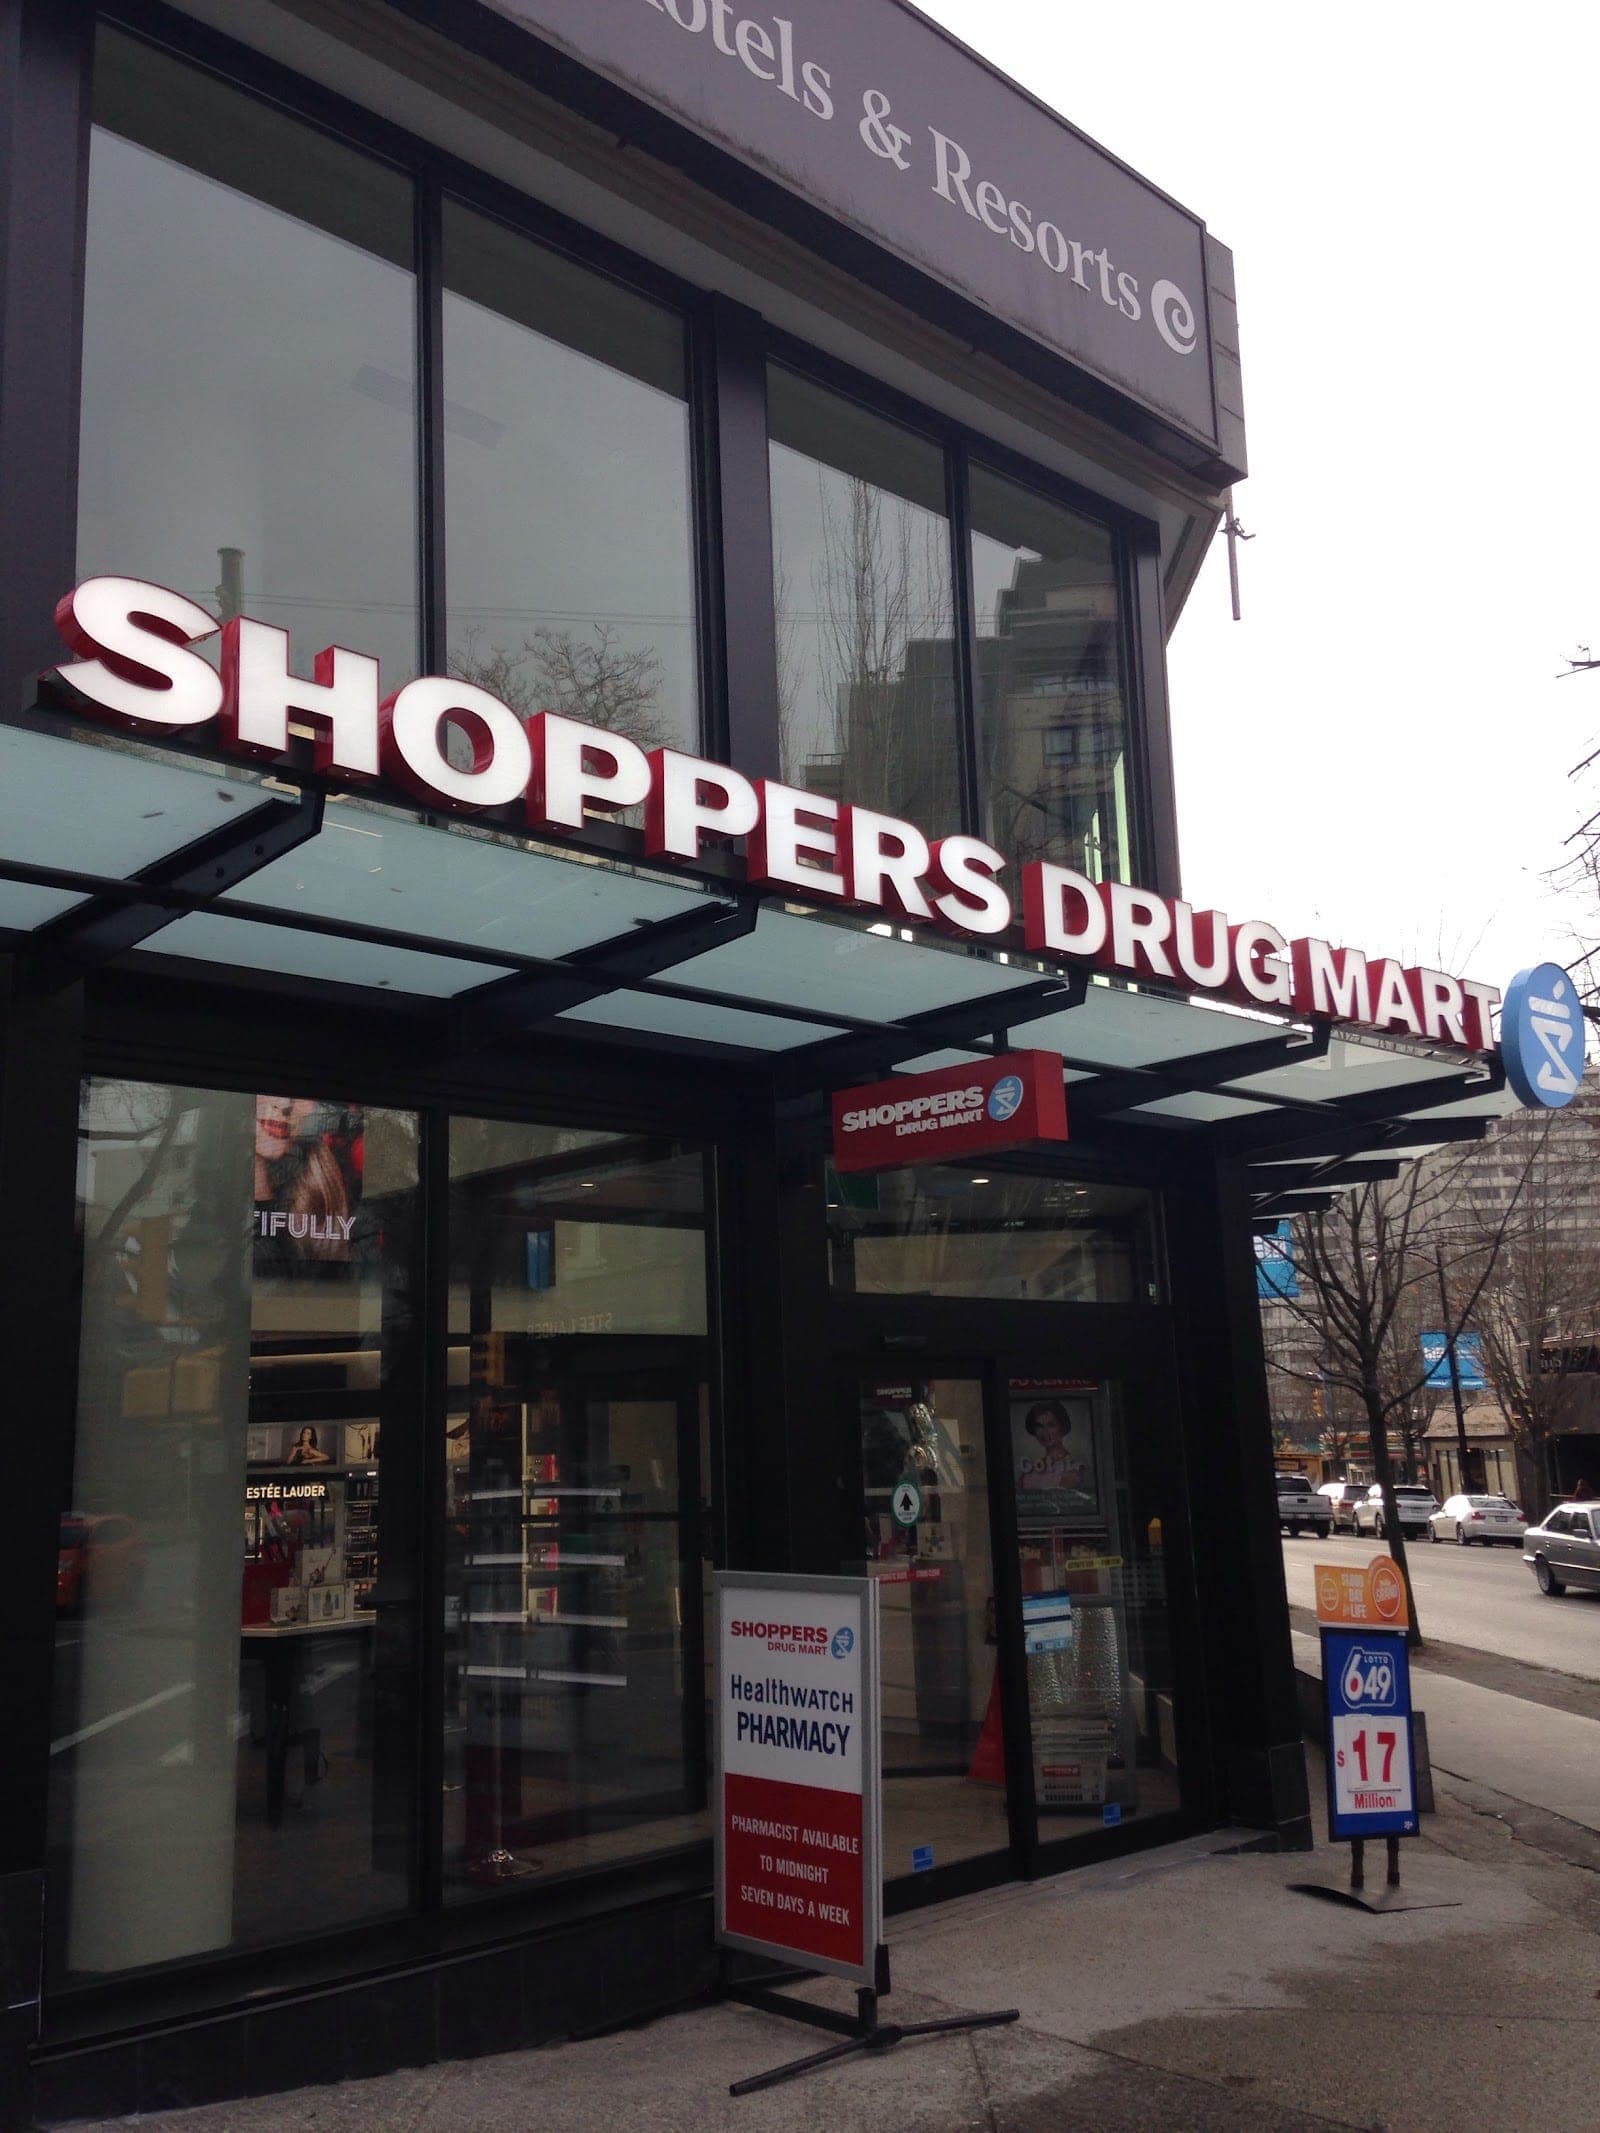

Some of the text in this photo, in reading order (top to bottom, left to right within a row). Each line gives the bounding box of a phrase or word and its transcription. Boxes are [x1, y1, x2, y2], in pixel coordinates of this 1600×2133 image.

[644, 0, 1142, 322] otels & Resorts
[55, 575, 1501, 1052] SHOPPERS DRUG MART
[841, 1086, 984, 1133] SHOPPERS
[895, 1108, 984, 1137] DRUG MART
[253, 1210, 357, 1241] IFULLY
[246, 1482, 327, 1499] ESTÉE LAUDER
[731, 1620, 828, 1643] SHOPPERS
[768, 1641, 828, 1656] DRUG MART
[1363, 1655, 1389, 1665] LOTTO
[731, 1673, 854, 1714] HealthWATCH
[737, 1711, 850, 1757] PHARMACY
[732, 1814, 859, 1855] PHARMACIST AVAILABLE
[760, 1854, 829, 1885] TO MIDNIGHT
[741, 1884, 850, 1926] SEVEN DAYS A WEEK
